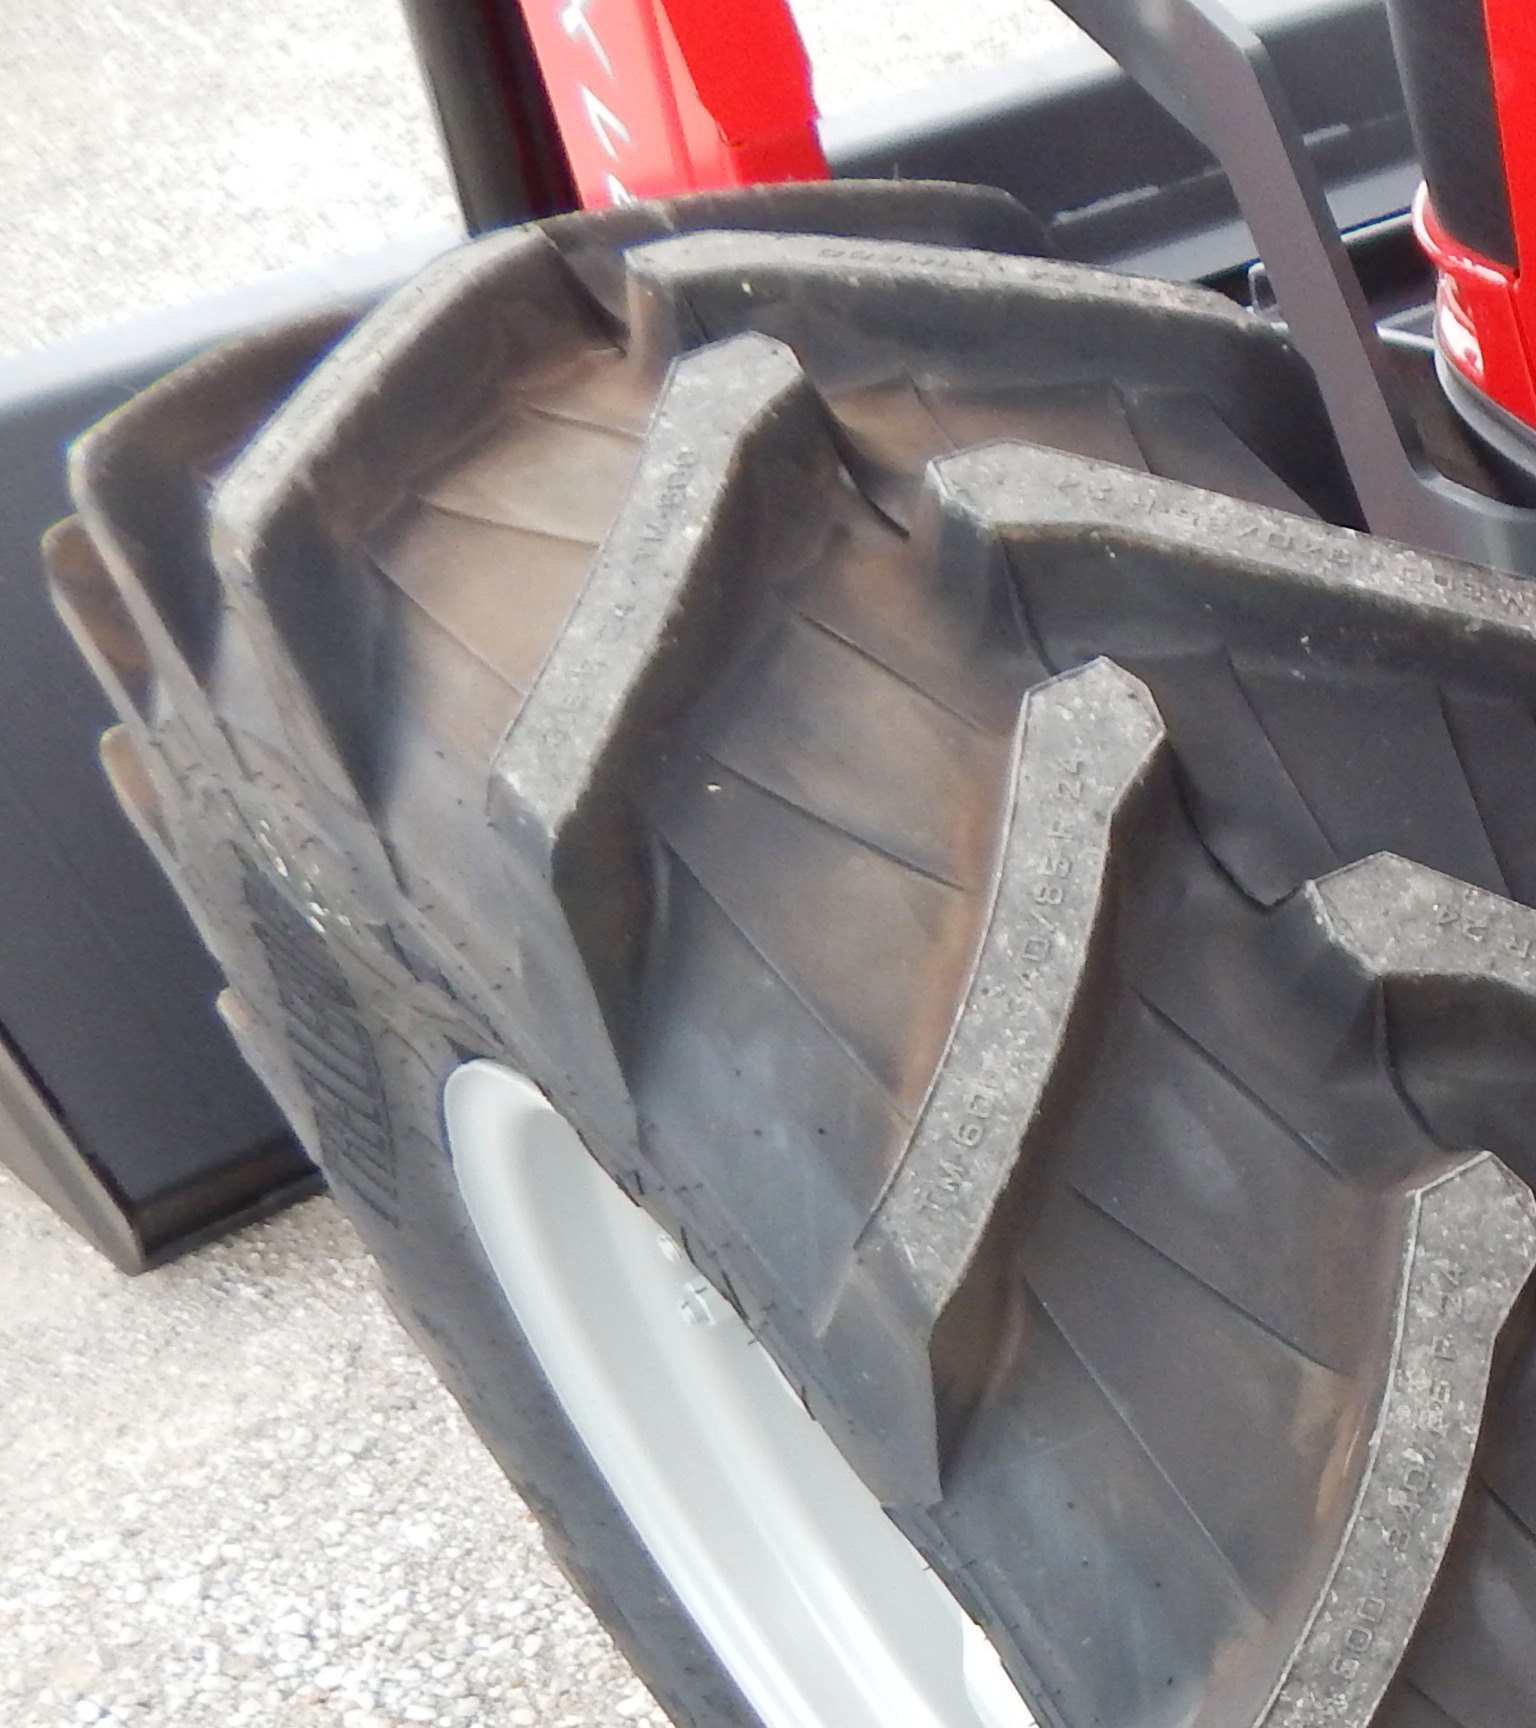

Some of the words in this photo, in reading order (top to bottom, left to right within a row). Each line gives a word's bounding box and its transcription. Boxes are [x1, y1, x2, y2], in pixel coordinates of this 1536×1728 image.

[1054, 756, 1085, 799] 24
[1045, 812, 1079, 844] R
[1004, 848, 1075, 1016] 340/85
[1426, 901, 1486, 943] 24
[1500, 931, 1529, 959] R
[914, 1159, 969, 1218] TM
[1329, 1594, 1390, 1682] 600
